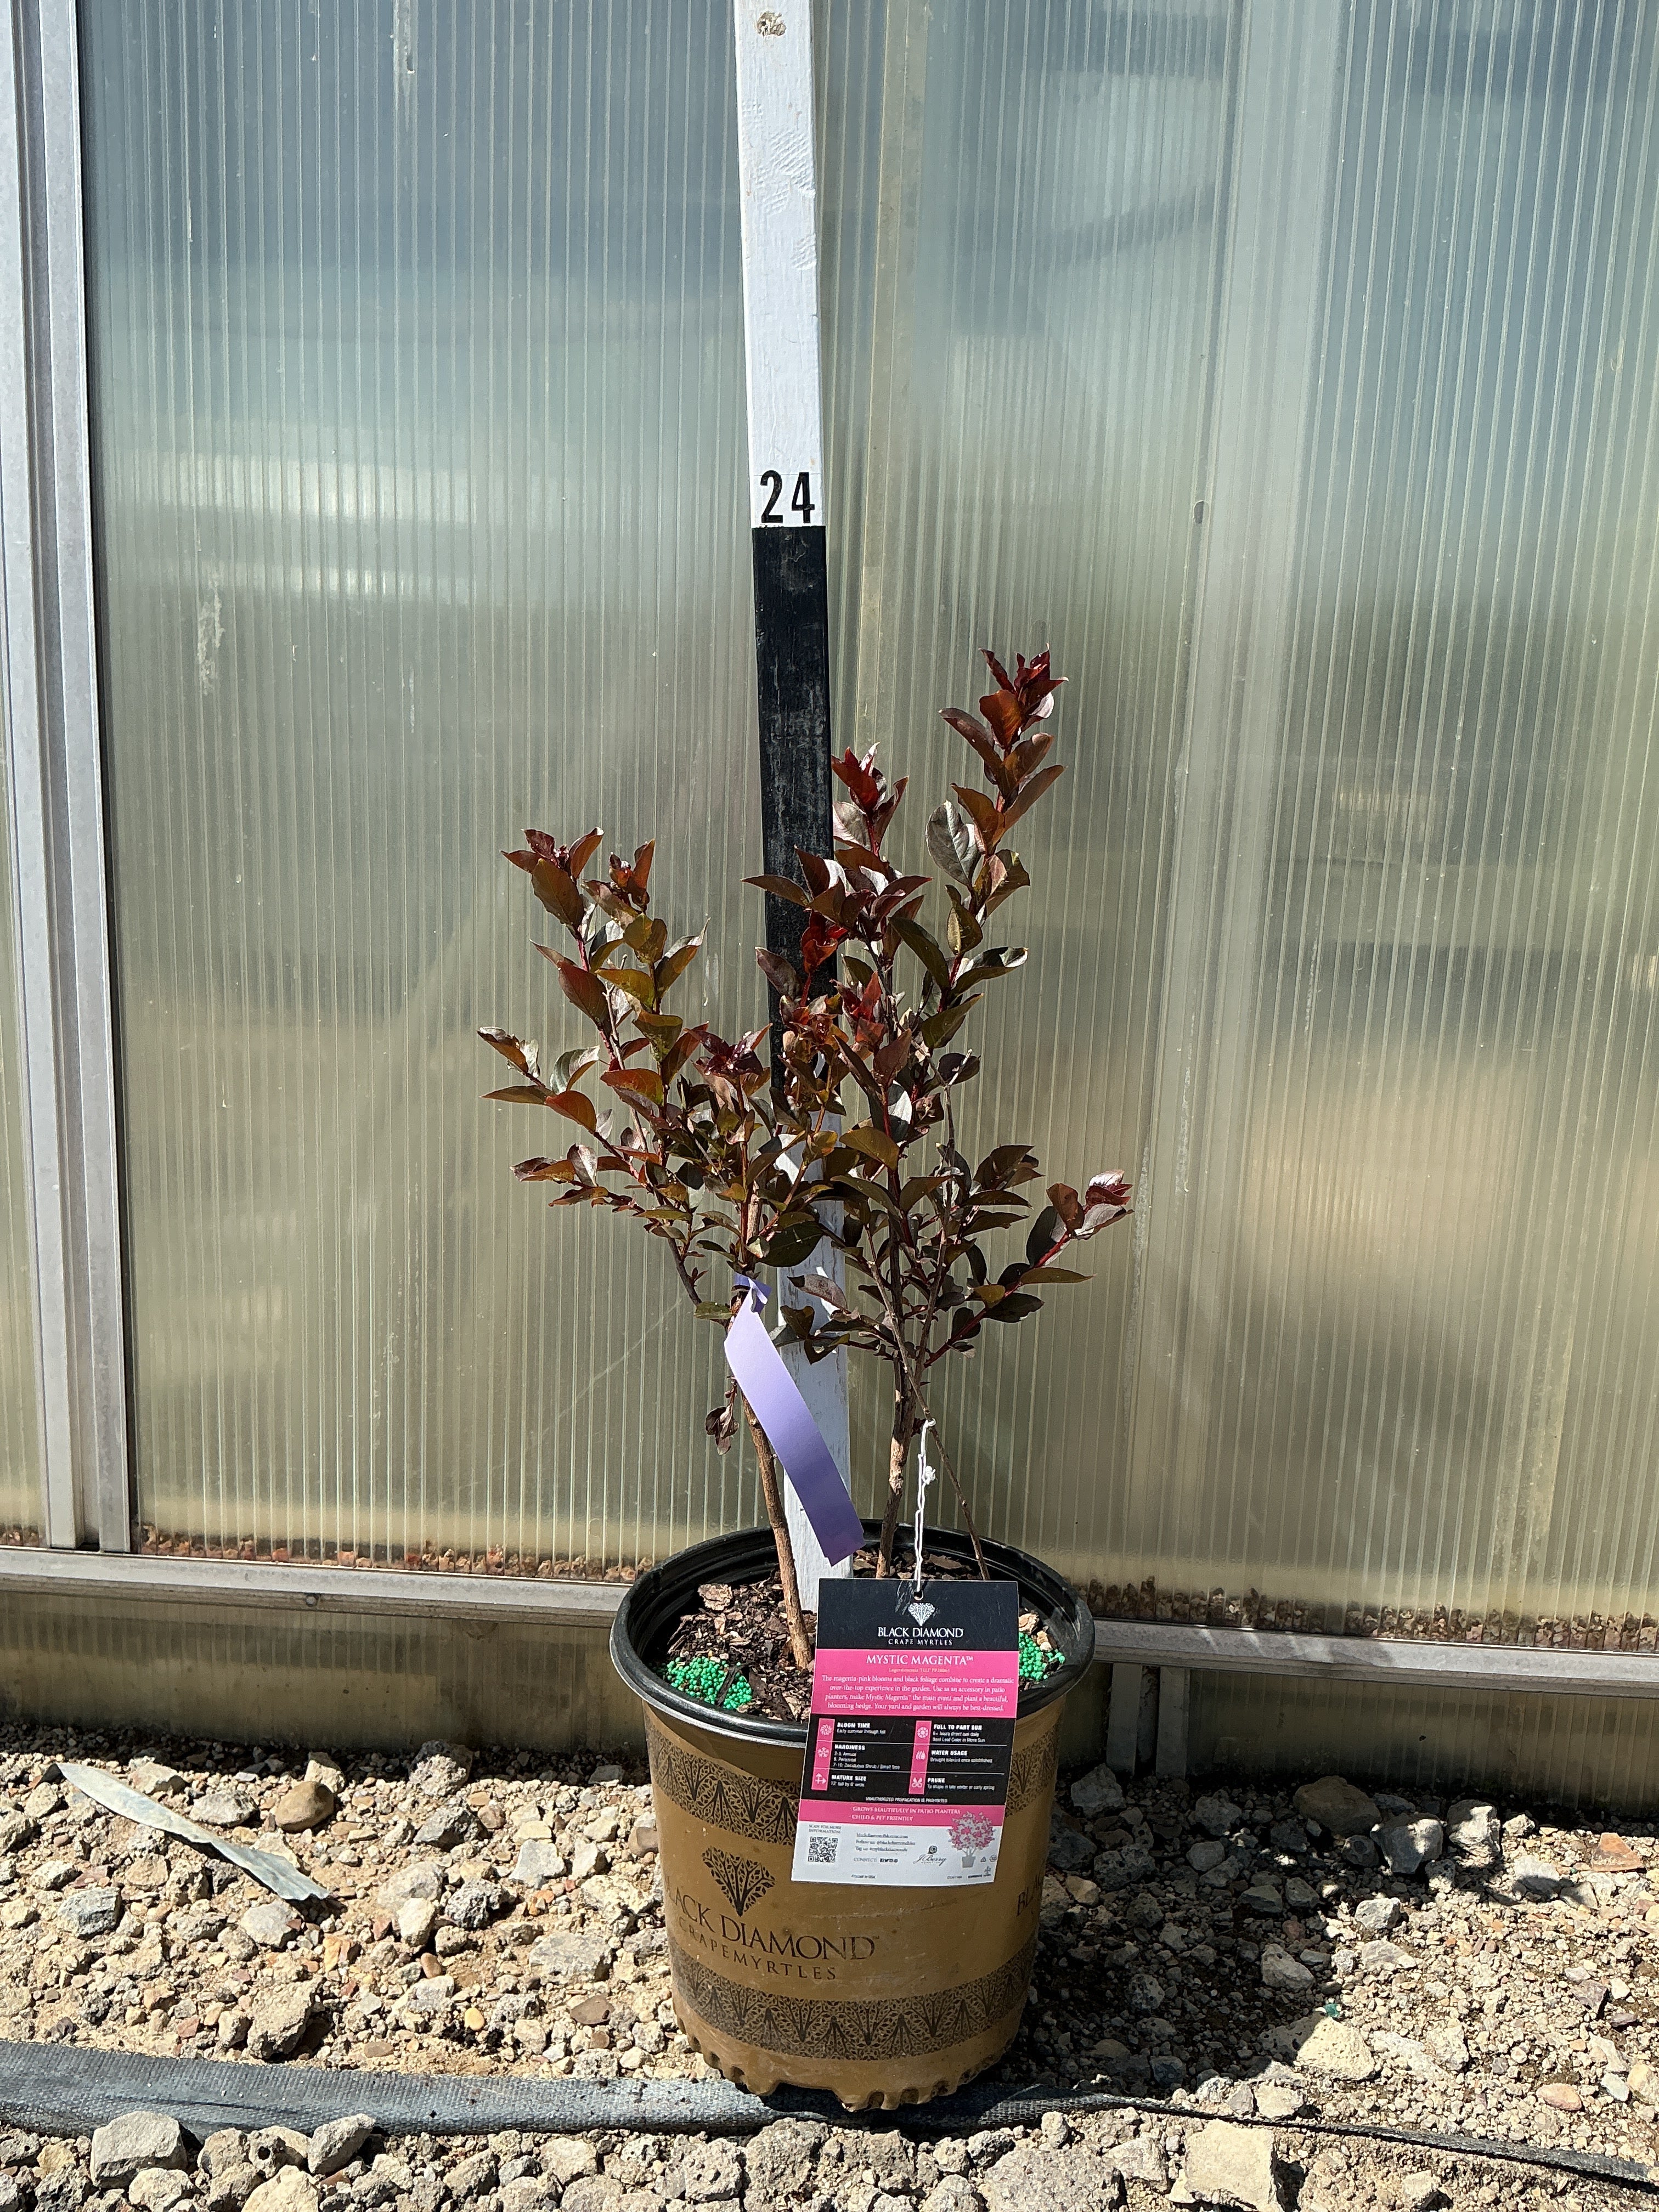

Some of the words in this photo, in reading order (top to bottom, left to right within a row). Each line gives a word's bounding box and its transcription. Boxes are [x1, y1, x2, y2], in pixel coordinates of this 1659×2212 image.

[760, 470, 815, 523] 24
[878, 1627, 910, 1637] BLACK
[866, 1655, 909, 1664] MYSTIC
[828, 1702, 854, 1710] blooming
